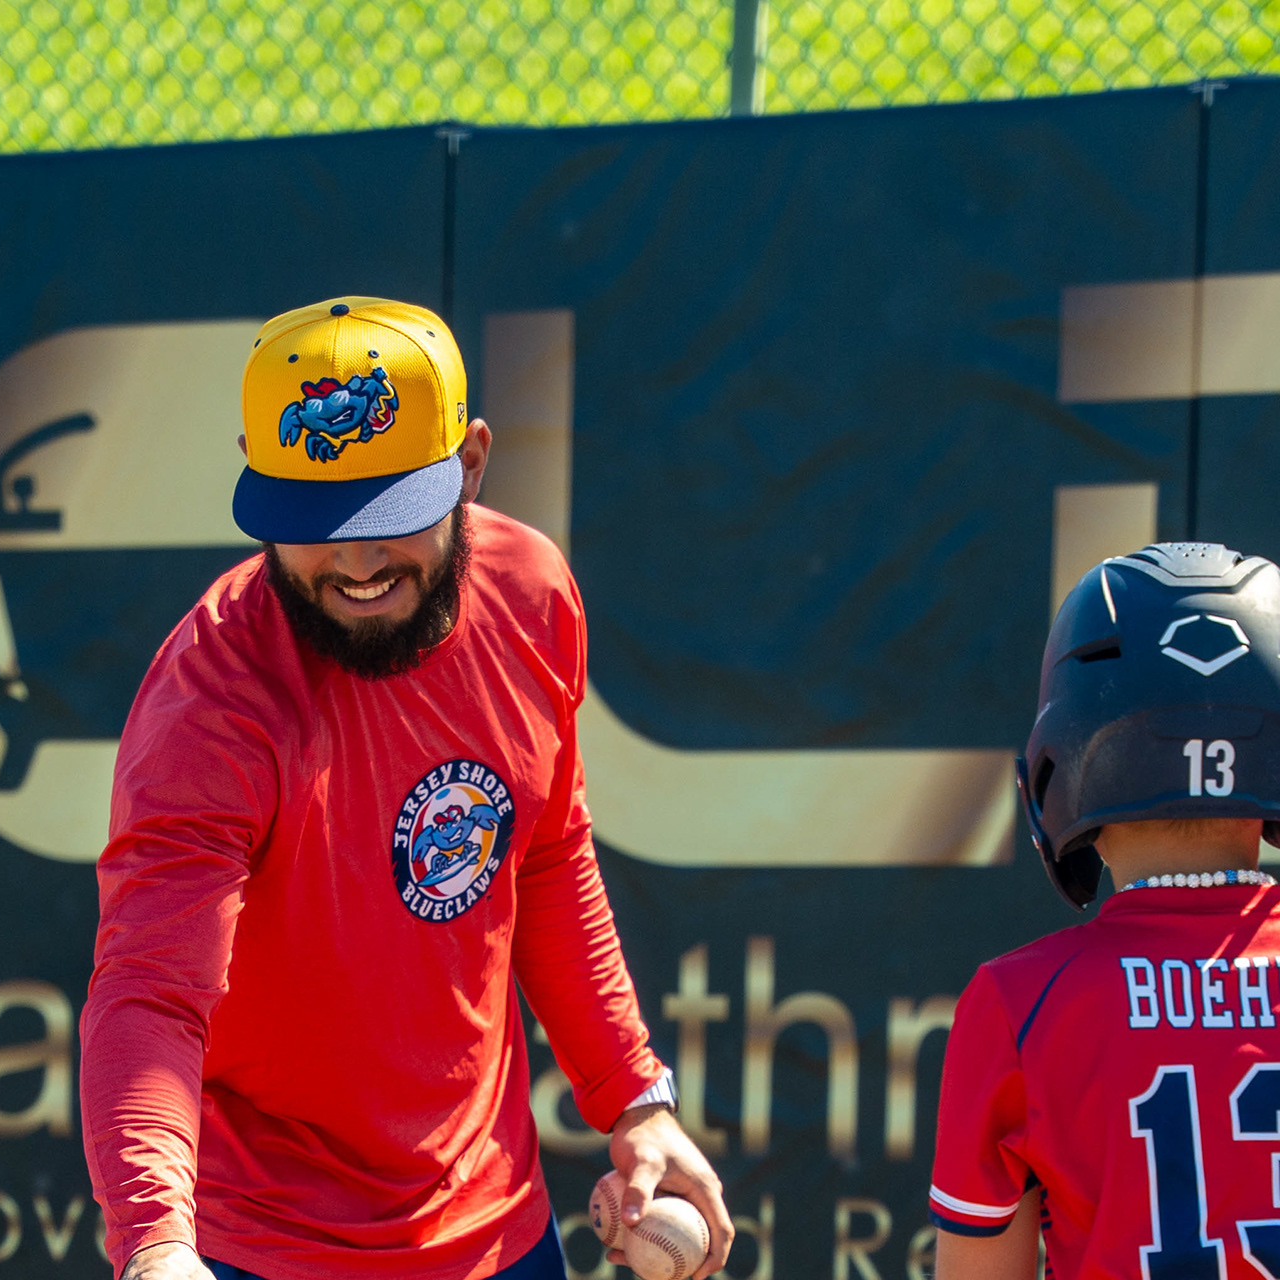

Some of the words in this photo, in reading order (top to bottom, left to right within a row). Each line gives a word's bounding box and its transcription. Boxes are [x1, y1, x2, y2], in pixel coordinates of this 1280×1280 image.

[1182, 738, 1237, 798] 13
[394, 762, 453, 849] JERSEY
[458, 761, 513, 817] SHORE
[401, 856, 501, 921] BLUECLAWS
